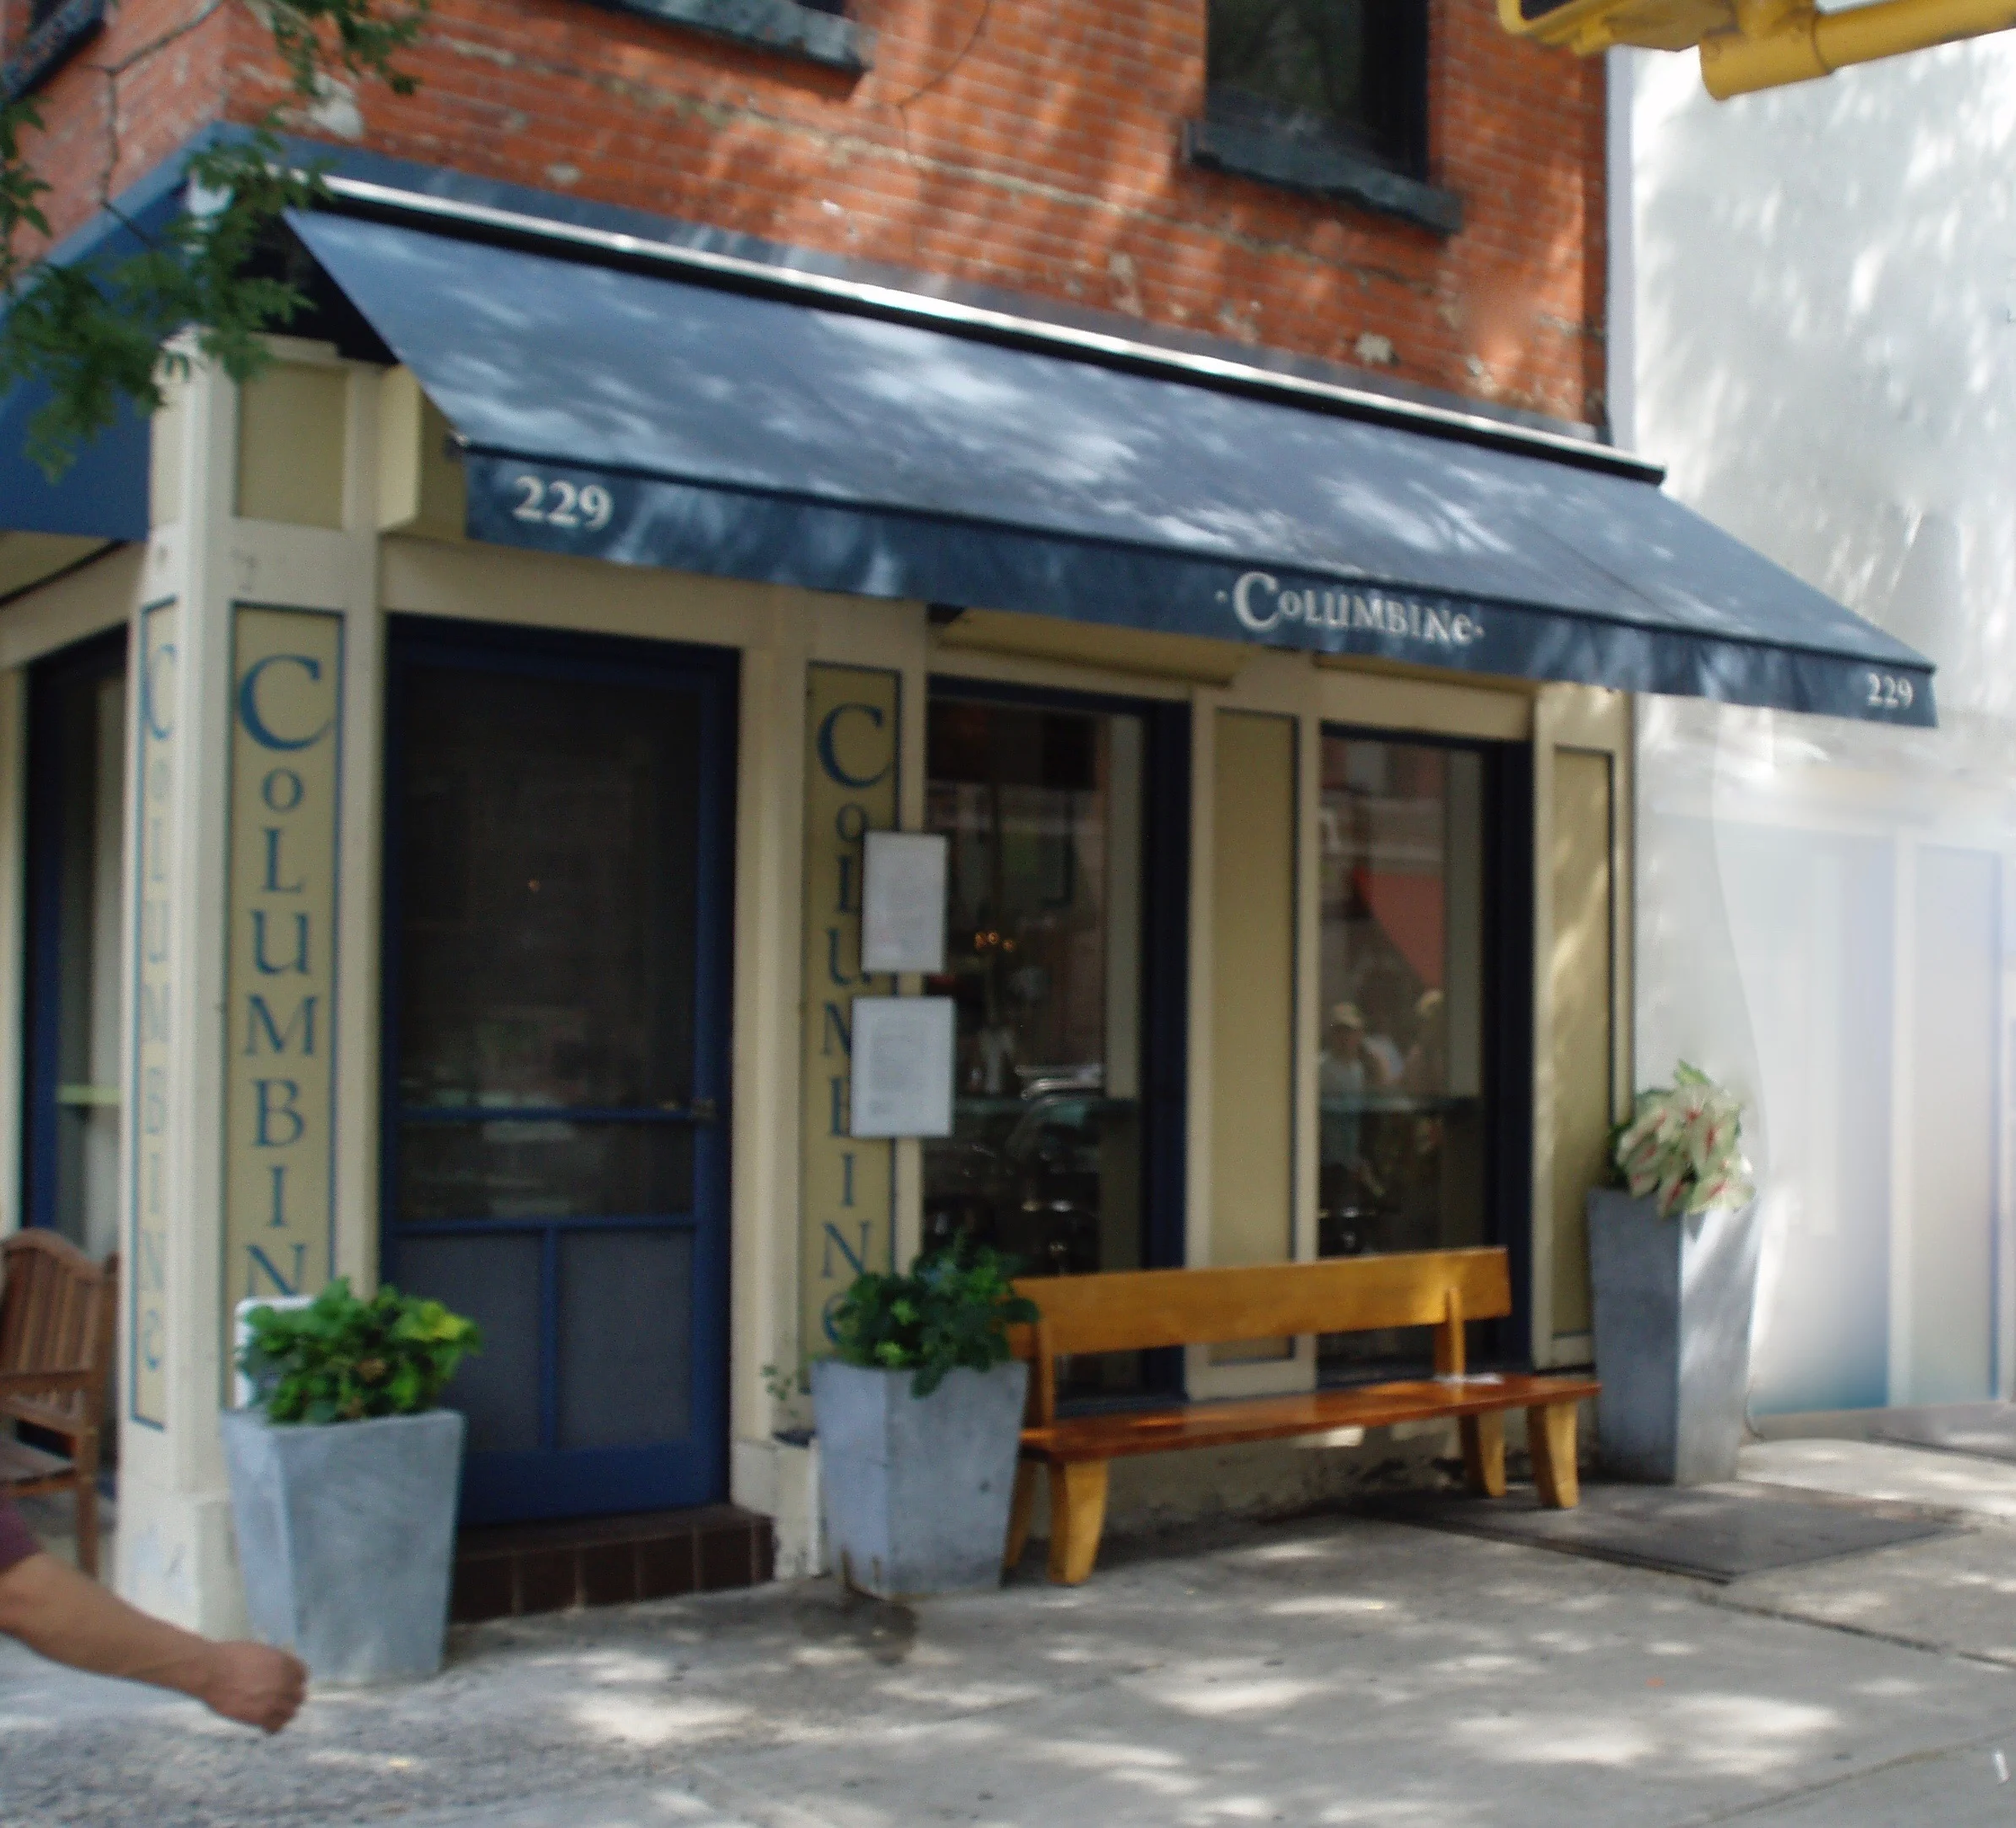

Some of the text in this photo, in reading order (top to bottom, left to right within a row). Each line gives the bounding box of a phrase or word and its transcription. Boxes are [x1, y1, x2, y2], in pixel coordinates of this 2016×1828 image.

[512, 475, 613, 528] 229
[1866, 673, 1915, 710] 229
[237, 653, 335, 1298] COLUMBIN
